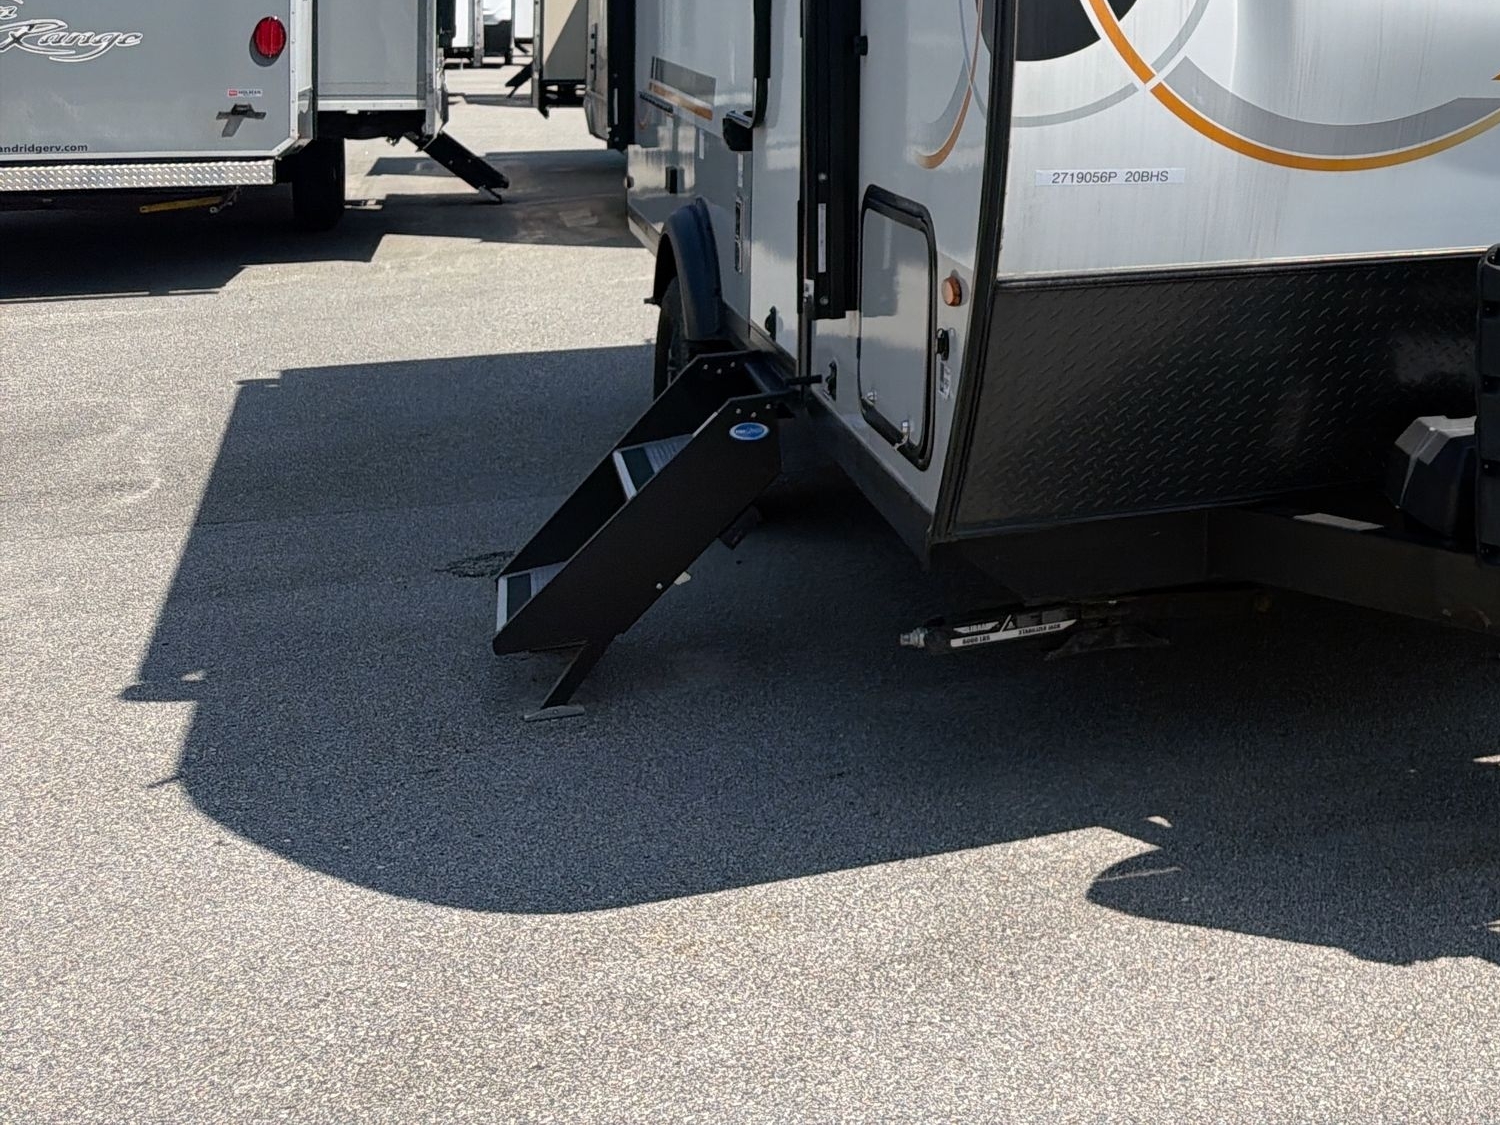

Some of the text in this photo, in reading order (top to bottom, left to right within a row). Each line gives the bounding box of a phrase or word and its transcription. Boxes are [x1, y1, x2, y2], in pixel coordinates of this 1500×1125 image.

[0, 19, 143, 62] Range
[1052, 170, 1169, 184] 2719056P 20BHS
